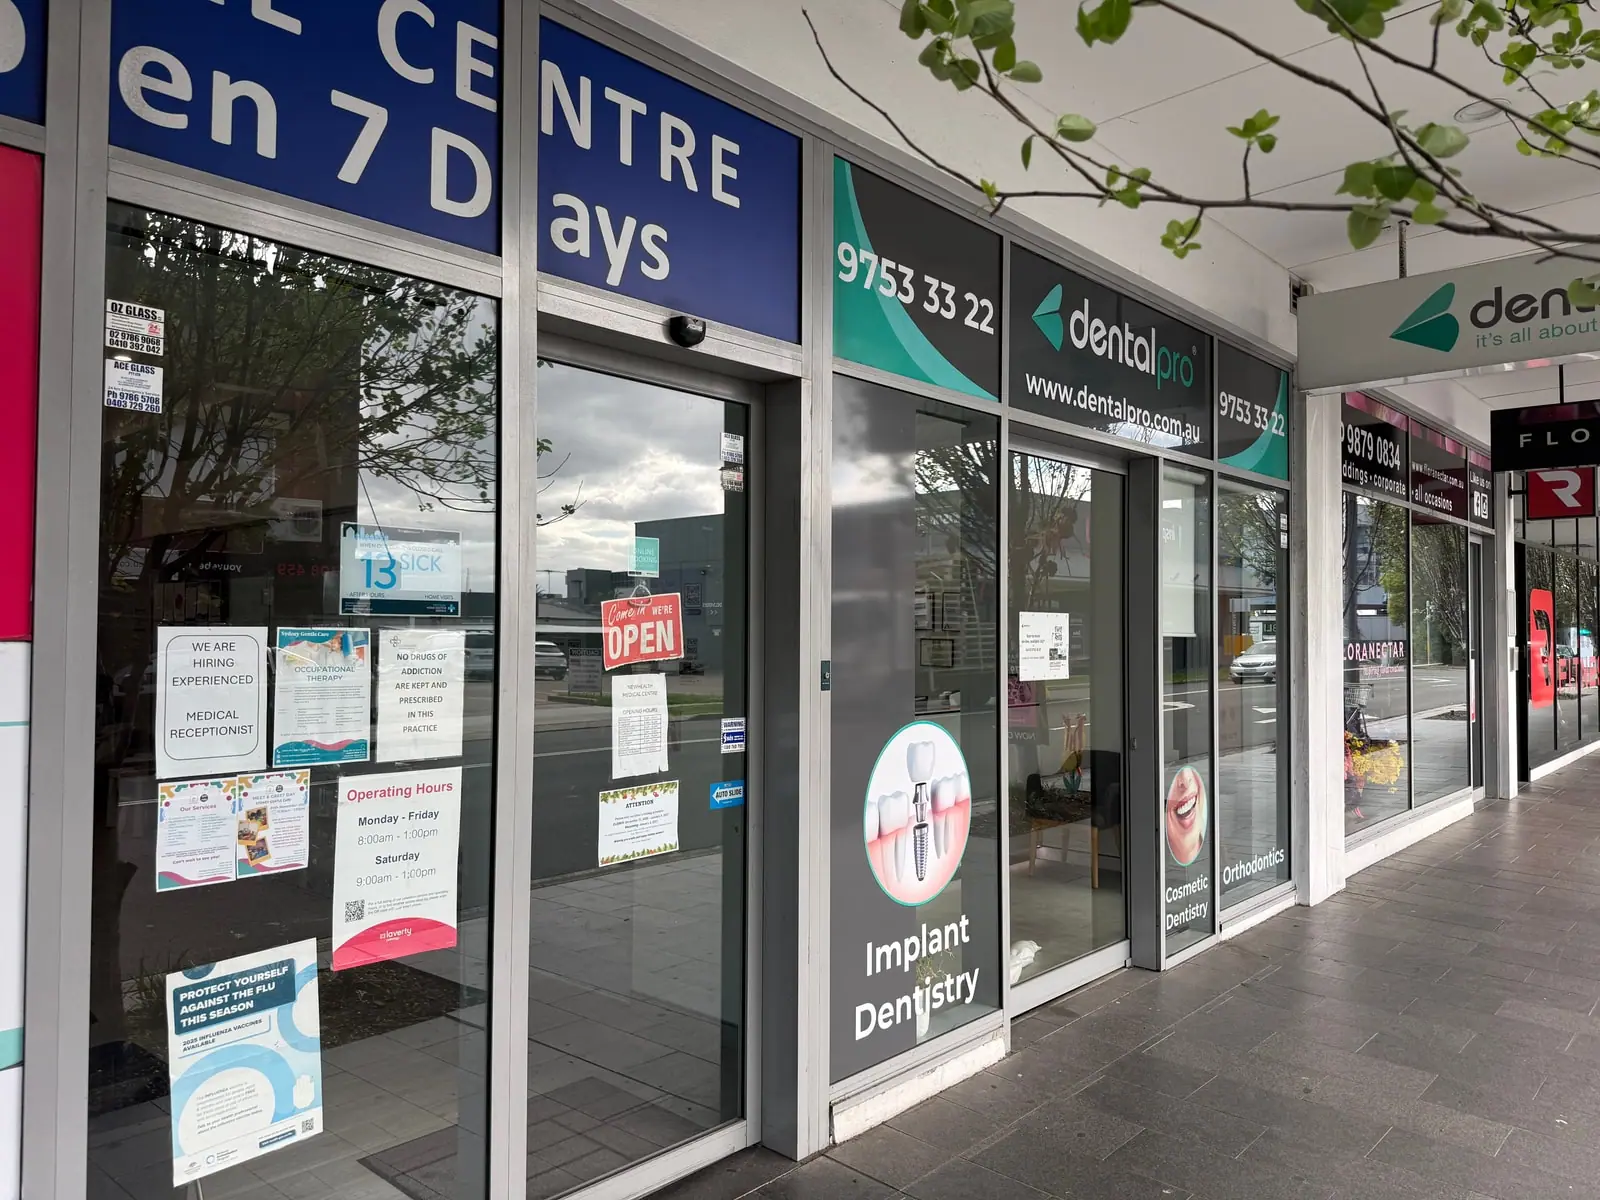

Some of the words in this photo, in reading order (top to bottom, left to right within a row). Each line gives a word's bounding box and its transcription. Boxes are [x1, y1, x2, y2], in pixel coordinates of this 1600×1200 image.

[331, 89, 388, 184] 7
[837, 241, 915, 304] 9753
[923, 274, 956, 320] 33
[964, 292, 994, 335] 22
[111, 302, 124, 313] OZ
[126, 305, 158, 321] GLASS
[109, 331, 120, 339] 02
[121, 332, 140, 342] 9786
[1476, 333, 1503, 348] it's
[1510, 327, 1531, 344] all
[1539, 318, 1598, 339] about
[109, 338, 128, 348] 0410
[1069, 298, 1194, 390] dentalpro
[114, 361, 129, 371] ACE
[131, 363, 155, 375] GLASS
[107, 390, 118, 399] Ph
[119, 392, 139, 402] 9786
[1025, 373, 1200, 442] www.dentalpro.com.au
[1219, 391, 1252, 425] 9753
[1254, 404, 1269, 431] 33
[1271, 411, 1285, 437] 22
[1347, 424, 1374, 461] 9879
[1377, 436, 1401, 471] 0834
[1374, 473, 1406, 496] corporate
[1414, 483, 1423, 502] all
[1424, 491, 1453, 512] occasions
[360, 551, 397, 590] 13
[400, 553, 442, 573] SICK
[652, 604, 672, 615] WE'RE
[192, 642, 211, 652] WE
[213, 642, 236, 652] ARE
[608, 619, 674, 660] OPEN
[193, 658, 235, 668] HIRING
[397, 653, 409, 661] NO
[411, 653, 436, 661] DRUGS
[437, 653, 448, 661] OF
[401, 667, 443, 675] ADDICTION
[172, 675, 254, 687] EXPERIENCED
[395, 682, 410, 690] ARE
[431, 681, 448, 689] AND
[399, 695, 443, 704] PRESCRIBED
[186, 710, 239, 721] MEDICAL
[407, 711, 416, 719] IN
[418, 710, 434, 718] THIS
[170, 725, 254, 739] RECEPTIONIST
[402, 724, 438, 733] PRACTICE
[347, 786, 412, 803] Operating
[416, 782, 453, 794] Hours
[716, 790, 728, 798] AUTO
[729, 788, 742, 797] SLIDE
[192, 803, 217, 811] Services
[626, 799, 654, 809] ATTENTION
[358, 813, 399, 827] Monday
[408, 810, 439, 821] Friday
[357, 833, 394, 846] 8:00am
[403, 827, 438, 841] 1:00pm
[375, 851, 420, 865] Saturday
[1222, 847, 1285, 885] Orthodontics
[356, 873, 392, 887] 9:00am
[402, 867, 436, 881] 1:00pm
[1165, 874, 1209, 904] Cosmetic
[1165, 901, 1209, 931] Dentistry
[866, 914, 970, 977] Implant
[179, 981, 232, 1002] PROTECT
[233, 966, 289, 987] YOURSELF
[179, 994, 230, 1015] AGAINST
[232, 989, 253, 1001] THE
[255, 981, 276, 994] FLU
[854, 967, 980, 1041] Dentistry
[180, 1013, 208, 1028] THIS
[209, 1000, 254, 1020] SEASON
[182, 1039, 198, 1047] 2025
[199, 1027, 233, 1041] INFLUENZA
[233, 1018, 263, 1031] VACCINES
[182, 1038, 216, 1052] AVAILABLE
